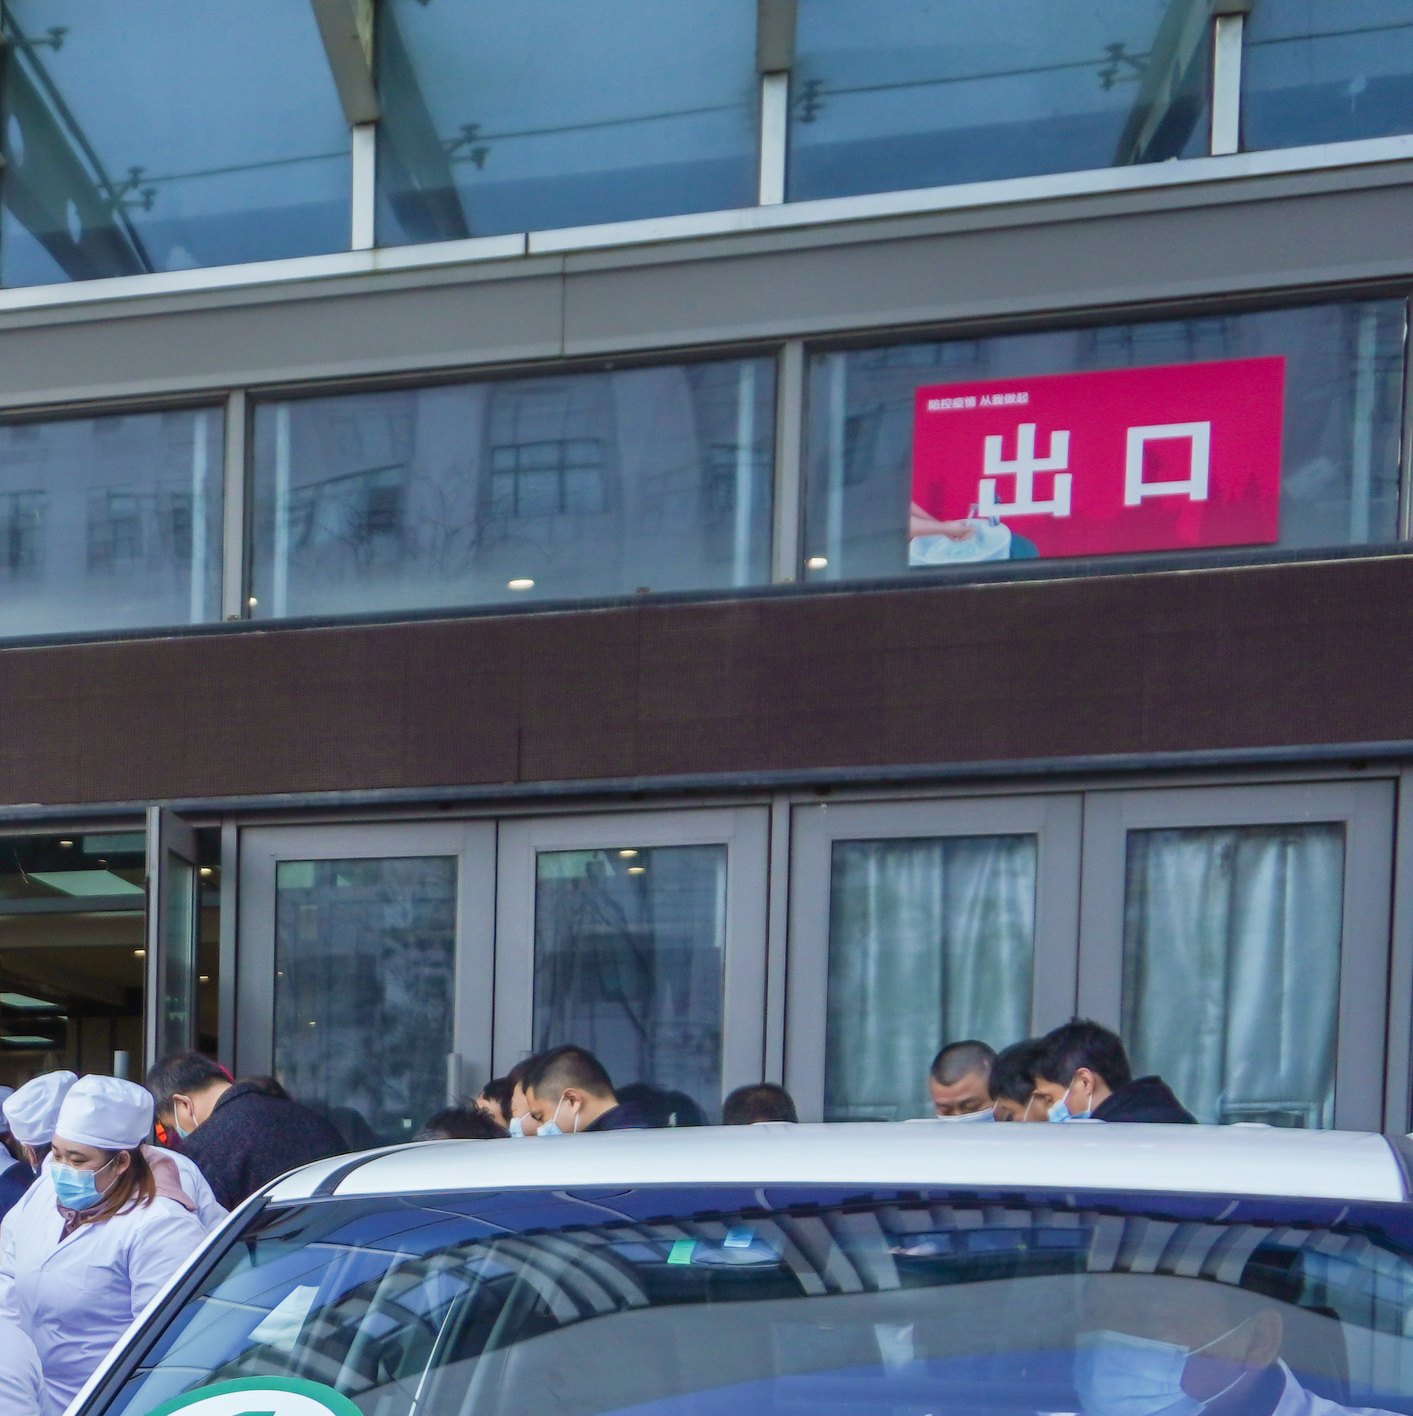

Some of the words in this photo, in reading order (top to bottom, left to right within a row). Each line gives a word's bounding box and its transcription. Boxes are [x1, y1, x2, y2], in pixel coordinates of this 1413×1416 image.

[980, 391, 1028, 406] 从我做起
[979, 421, 1211, 518] 出口
